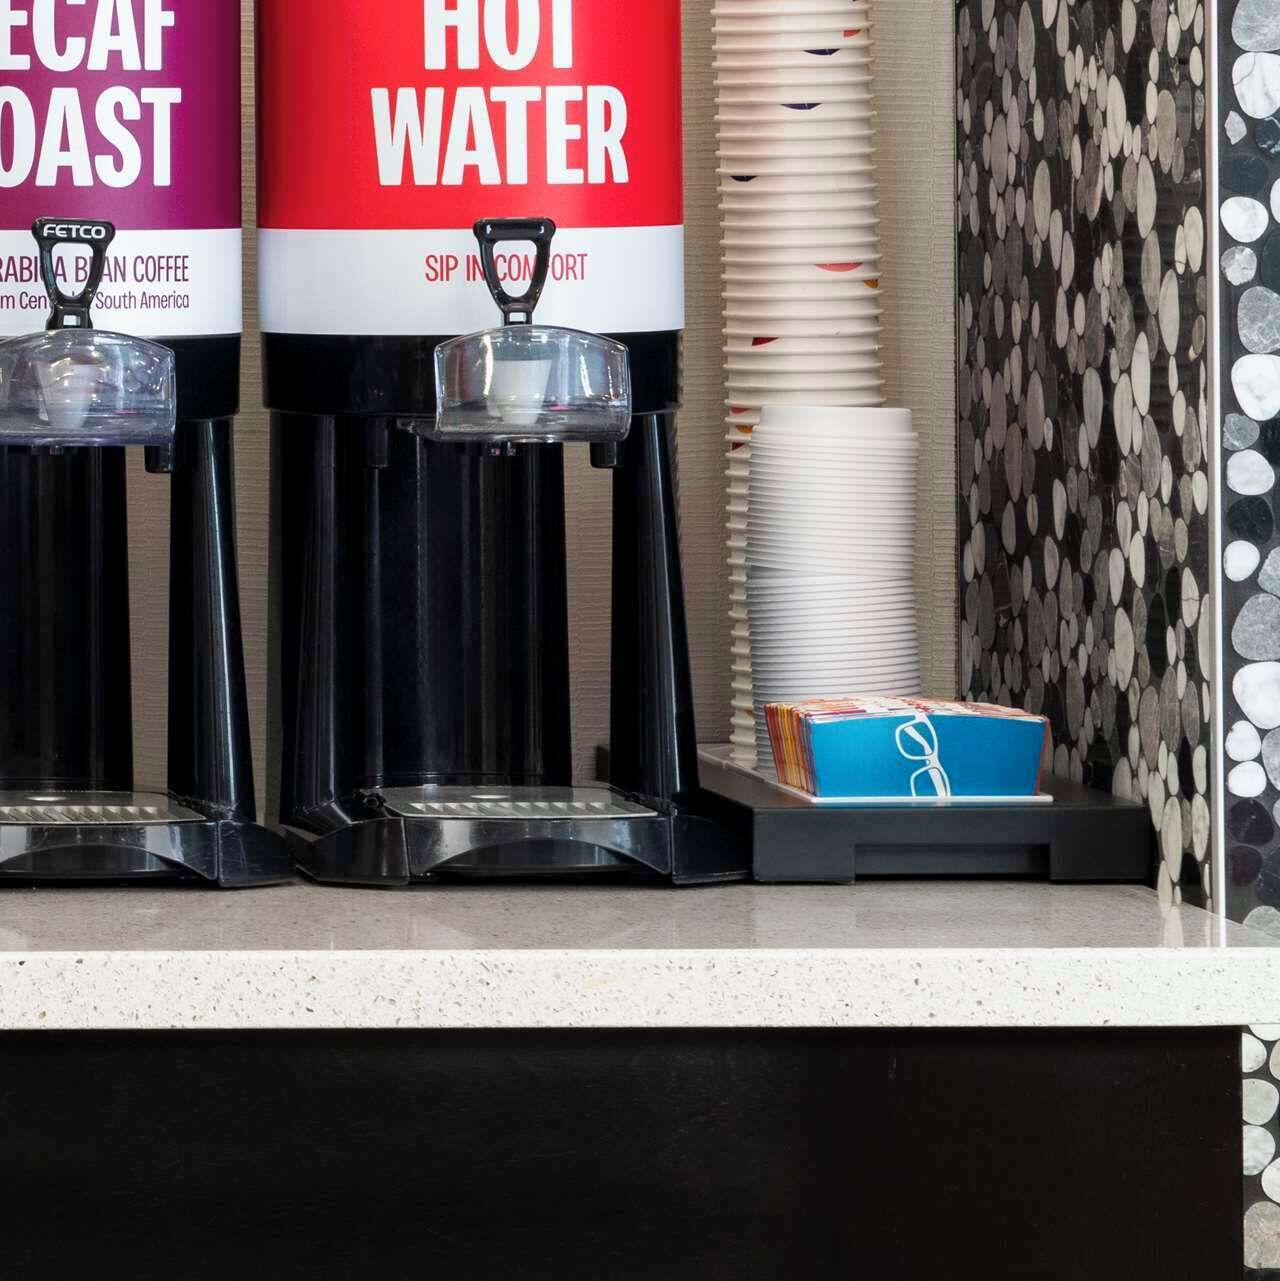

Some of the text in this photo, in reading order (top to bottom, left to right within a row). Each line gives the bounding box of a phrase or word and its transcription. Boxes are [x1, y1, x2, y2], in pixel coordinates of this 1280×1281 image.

[370, 85, 629, 186] WATER
[43, 223, 106, 240] FETCO
[74, 255, 127, 283] BAN
[133, 254, 189, 283] COFFEE
[425, 254, 459, 282] SIP
[494, 253, 588, 282] COMORT
[95, 291, 137, 309] South
[140, 290, 189, 309] America
